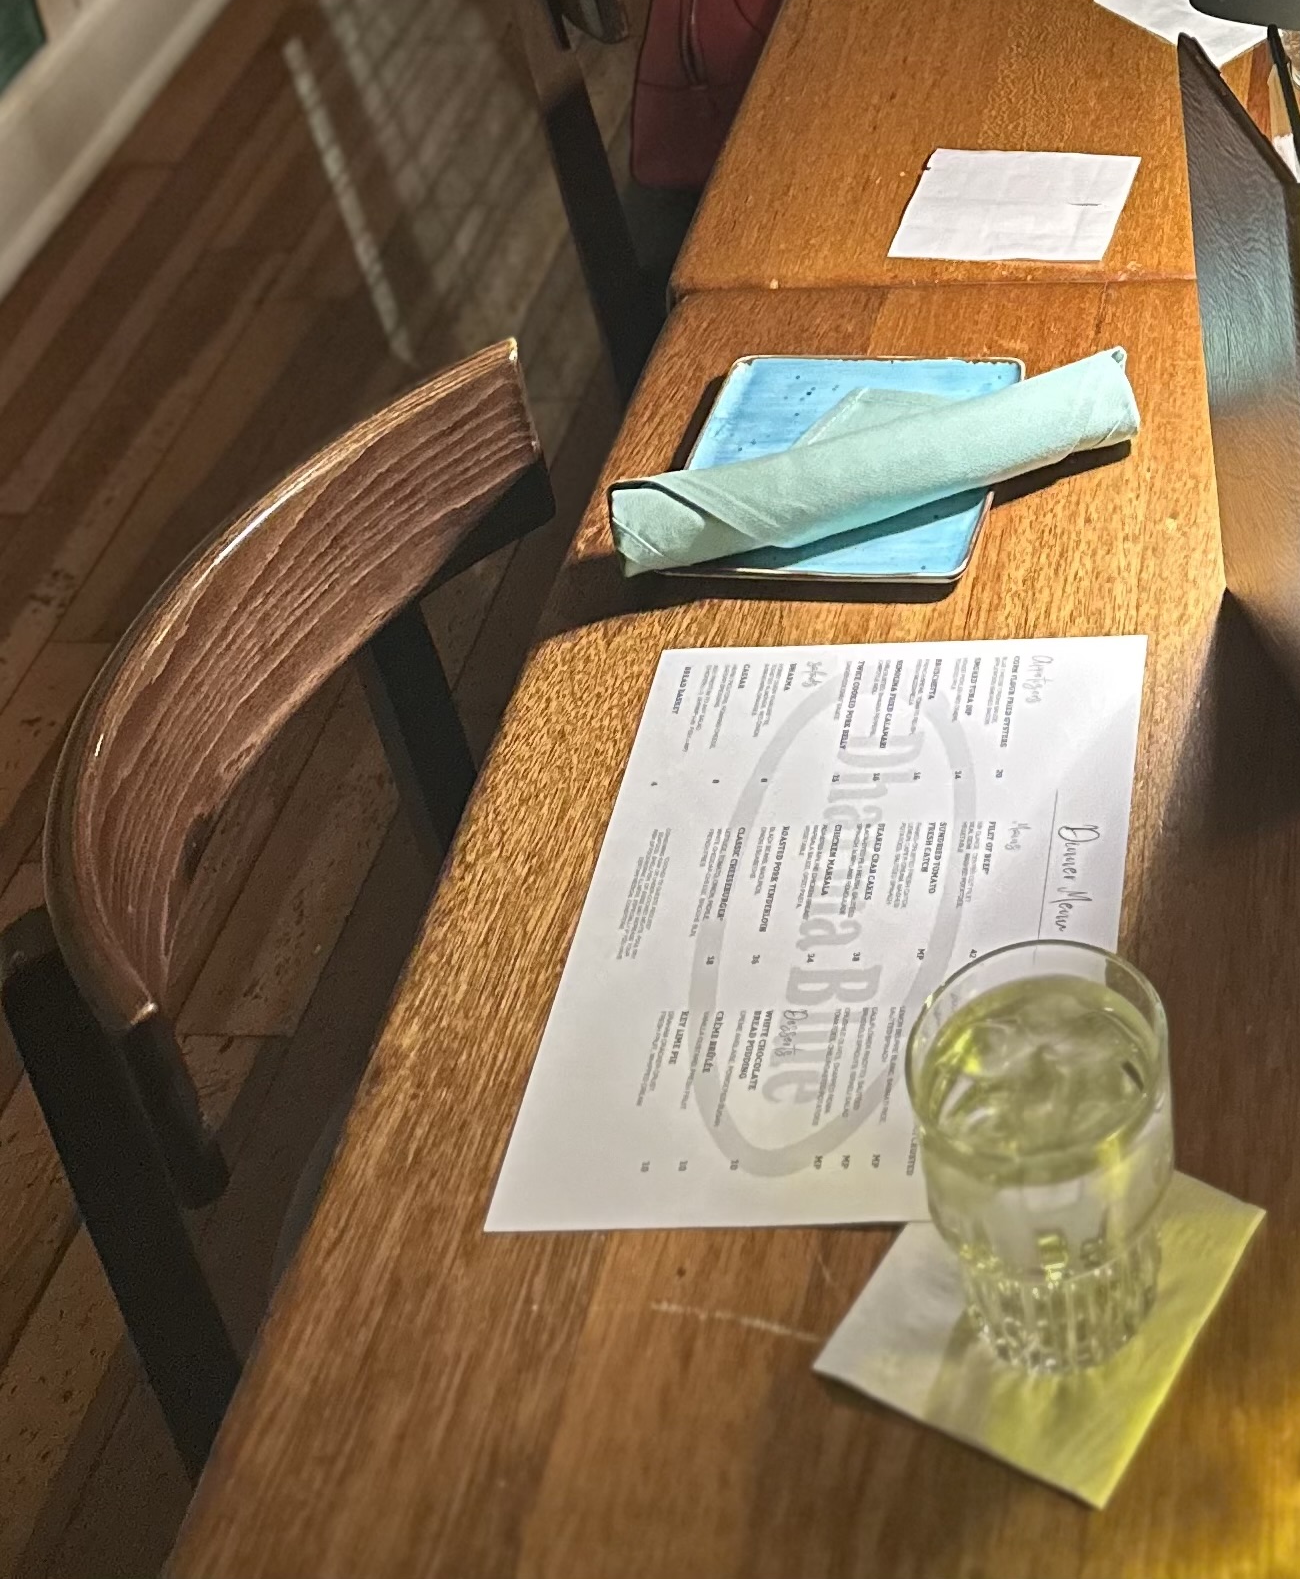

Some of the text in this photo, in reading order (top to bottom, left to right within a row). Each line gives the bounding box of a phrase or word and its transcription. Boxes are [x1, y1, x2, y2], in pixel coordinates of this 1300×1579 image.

[996, 769, 1003, 778] 20
[732, 827, 746, 857] CLASSIC
[987, 821, 996, 840] FILET
[821, 825, 842, 896] CHICKEN MARSALA
[921, 822, 936, 872] FRESH CATCH
[929, 822, 947, 894] SUNDRIED TOMATO
[985, 842, 993, 853] OF
[869, 854, 879, 873] CRAB
[759, 826, 790, 932] ROASTED PORK TENDERLOIN
[864, 875, 875, 900] CAKES
[1049, 825, 1100, 932] Dinner Menu
[761, 732, 926, 1104] Dharma Blue
[917, 949, 925, 960] MP
[969, 949, 977, 958] 42
[668, 1011, 689, 1065] KEY LIME PIE
[739, 1010, 761, 1080] BREAD PUDDING
[748, 1010, 773, 1091] WHITE CHOCOLATE
[814, 1155, 823, 1170] MP
[841, 1155, 850, 1169] MP
[872, 1154, 880, 1168] MP
